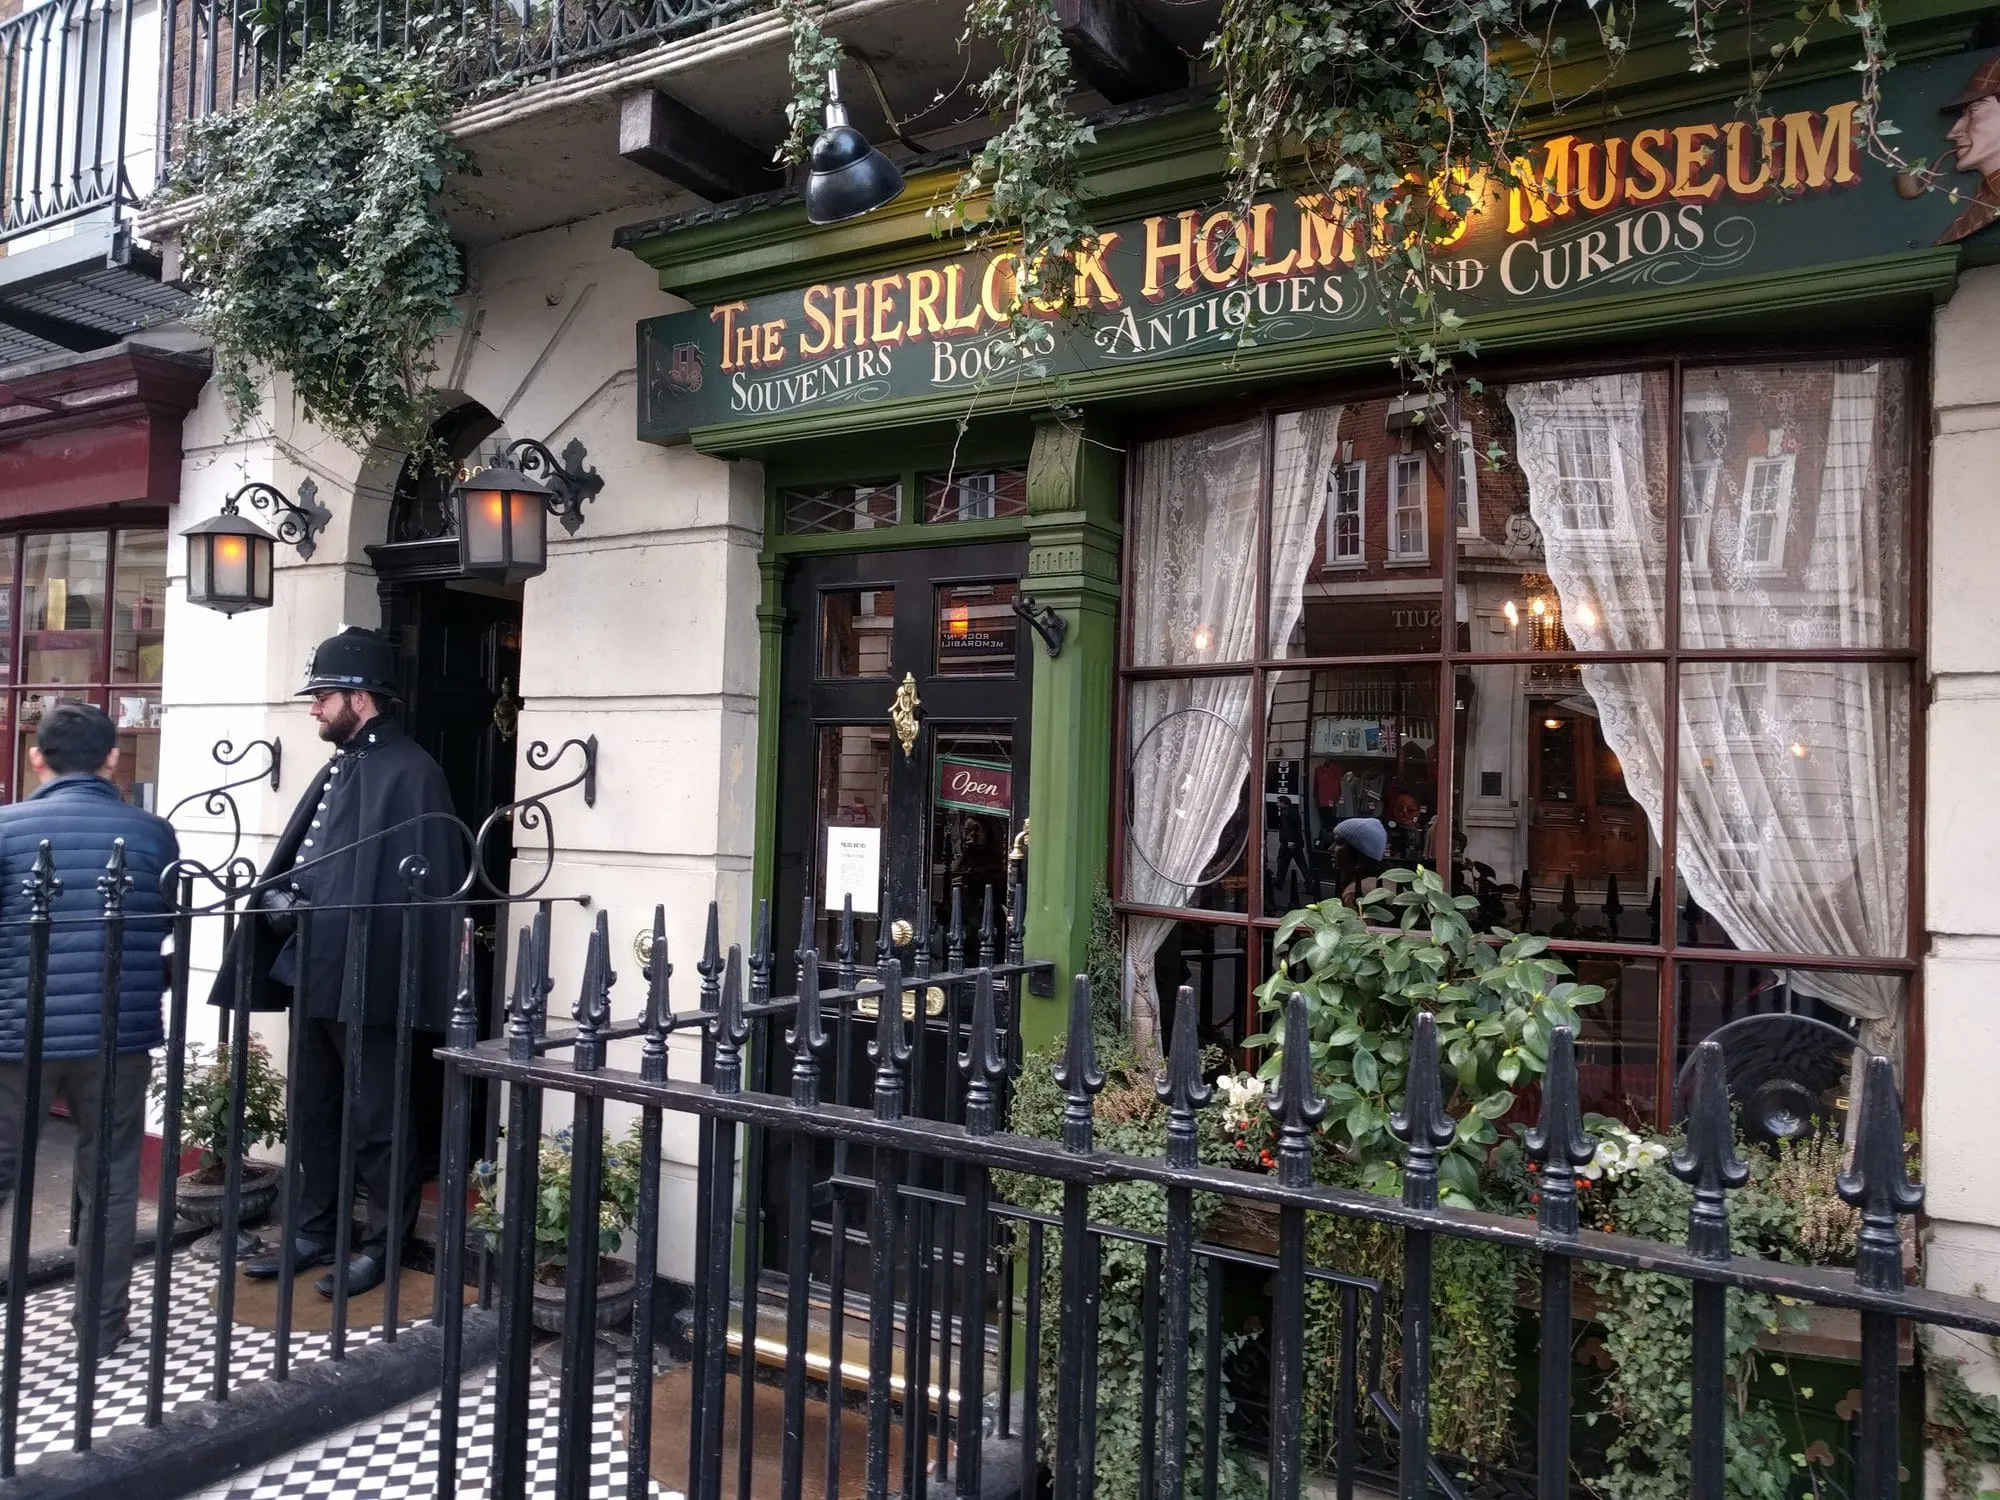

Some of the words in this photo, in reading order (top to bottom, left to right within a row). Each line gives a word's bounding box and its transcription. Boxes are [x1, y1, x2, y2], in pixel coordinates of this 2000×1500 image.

[710, 300, 787, 373] THE
[1505, 100, 1862, 235] MUSEUM
[730, 346, 892, 412] SOUVENIRS
[1095, 276, 1344, 354] ANTIQUES
[1400, 258, 1484, 298] AND
[1500, 205, 1705, 296] CURIOS
[951, 770, 999, 796] Open
